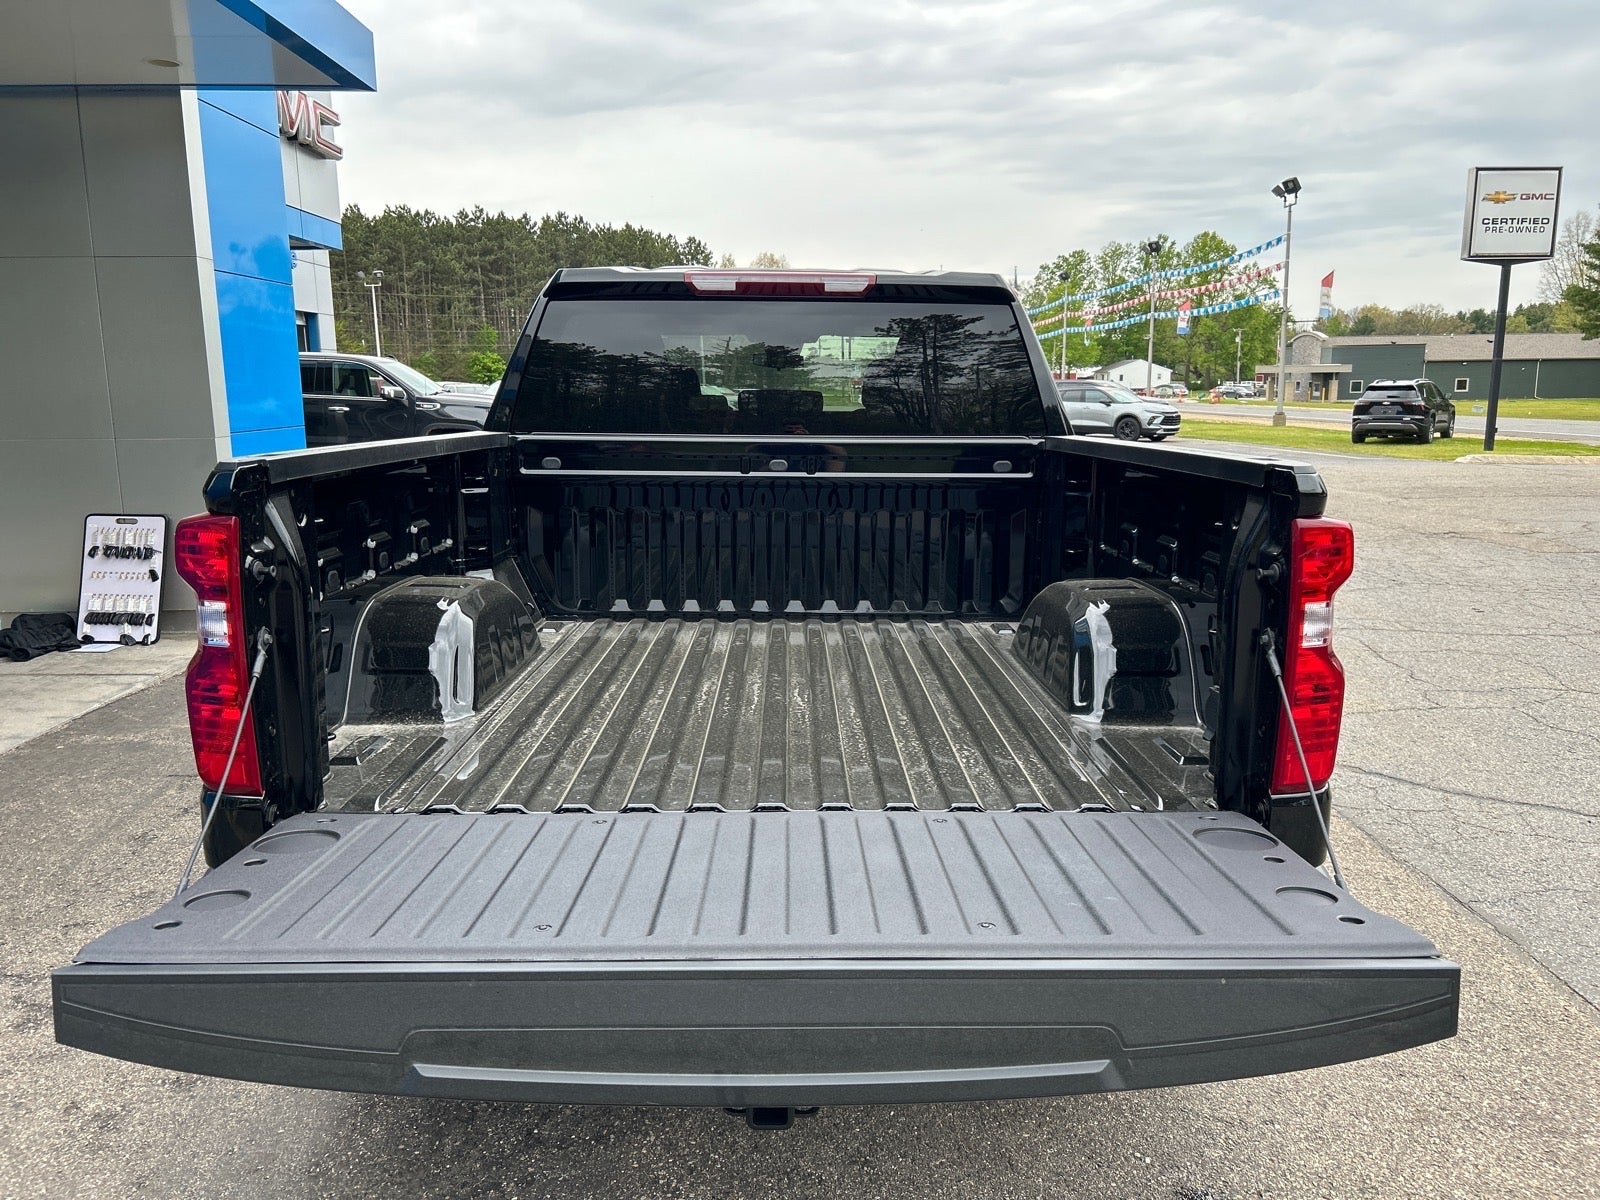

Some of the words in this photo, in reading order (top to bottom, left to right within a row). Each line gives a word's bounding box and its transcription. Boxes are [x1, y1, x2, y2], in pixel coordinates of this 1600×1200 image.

[1519, 193, 1555, 201] GMC
[1481, 217, 1550, 225] CERTIFIED
[1484, 226, 1546, 234] PRE-OWNED
